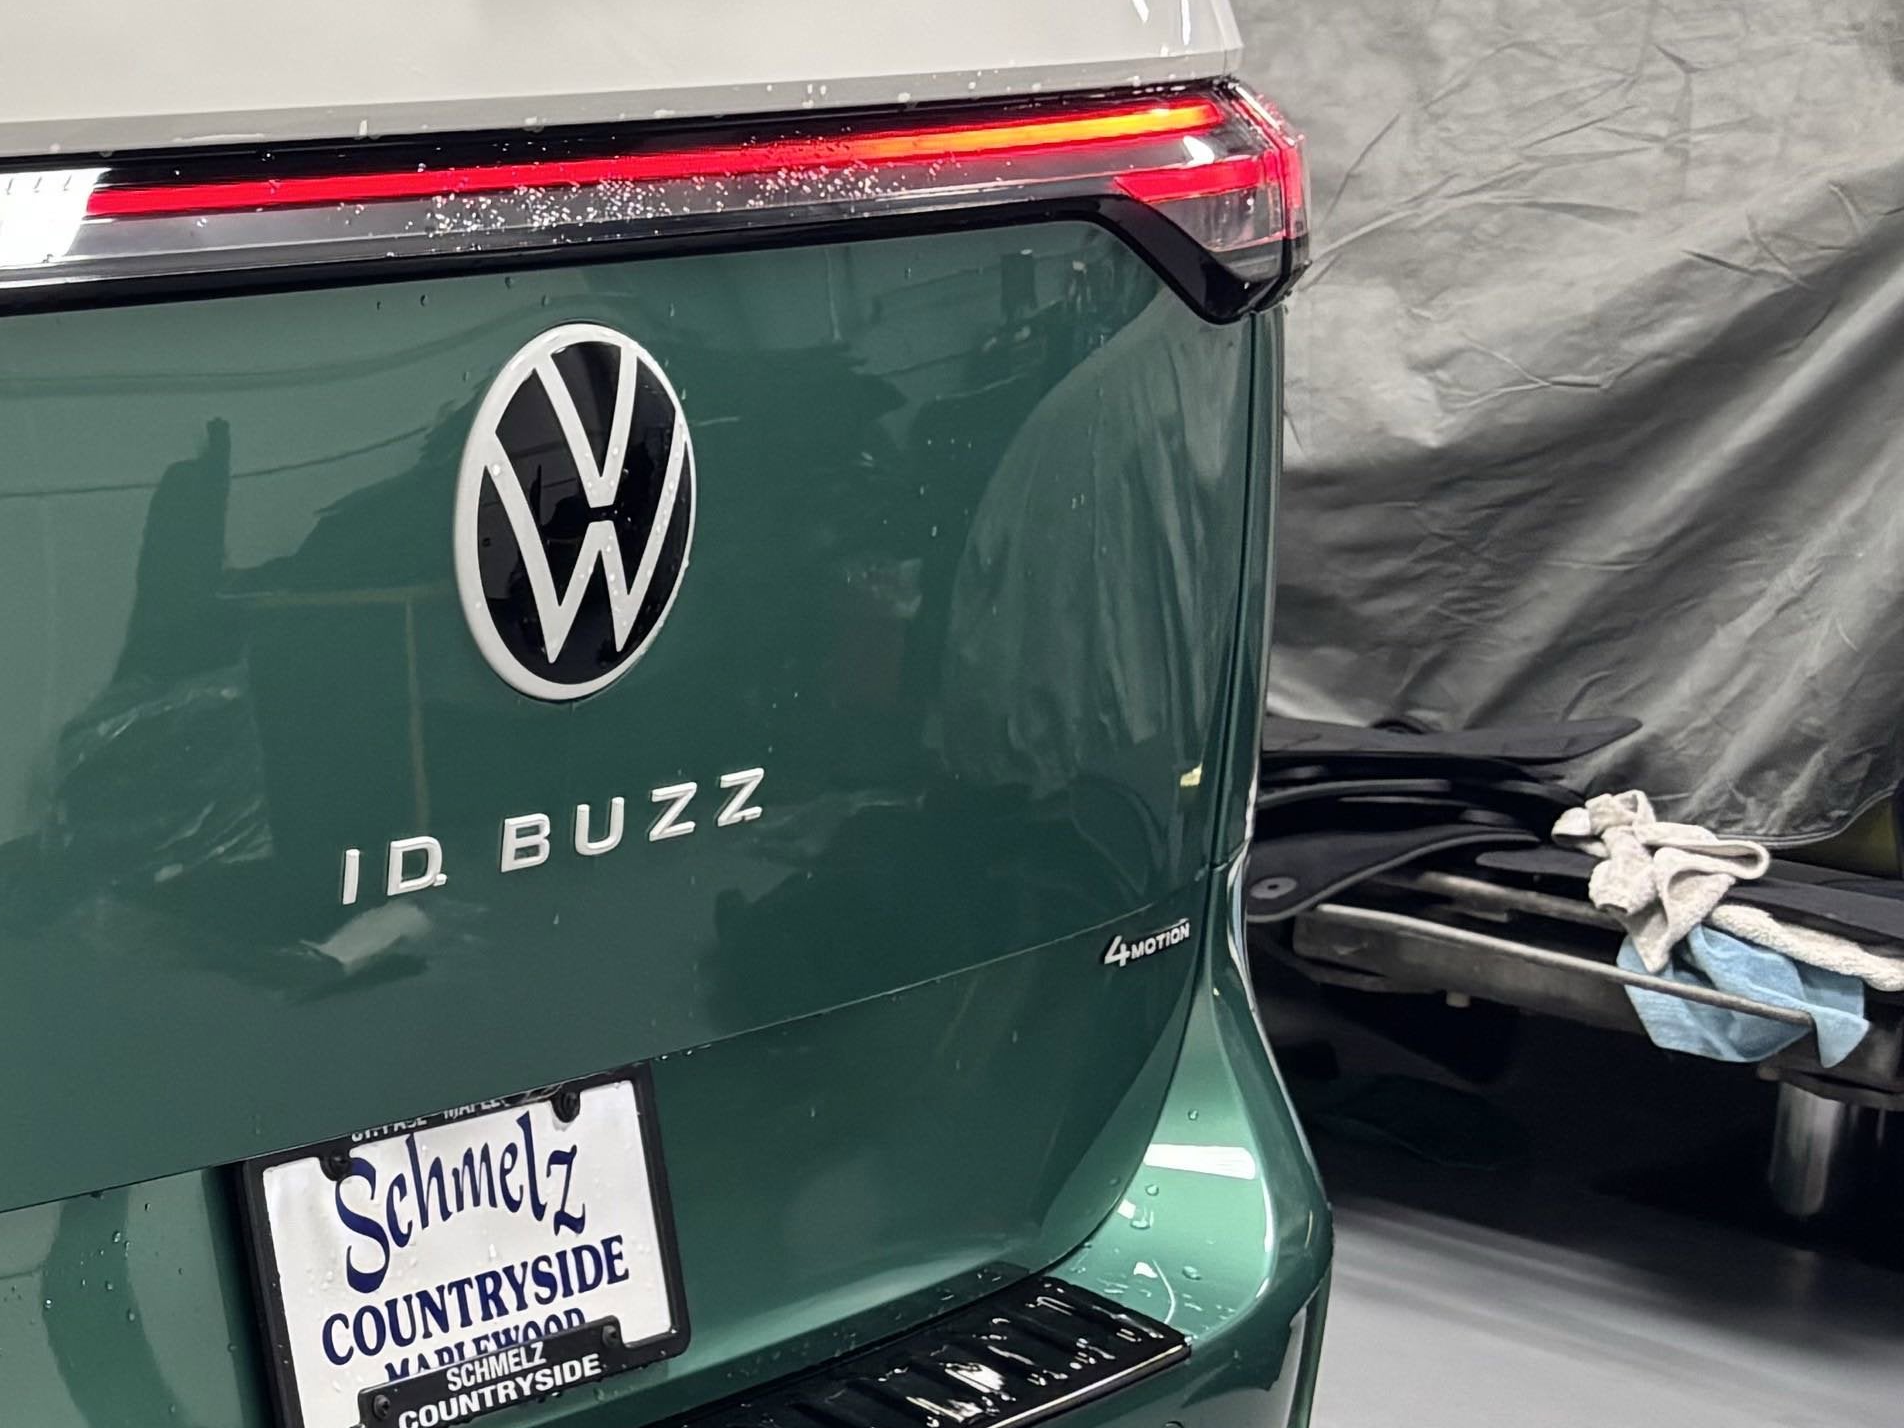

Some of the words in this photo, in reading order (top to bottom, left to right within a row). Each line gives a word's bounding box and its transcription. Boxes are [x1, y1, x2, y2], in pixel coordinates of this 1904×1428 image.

[462, 330, 695, 684] VW
[499, 766, 765, 873] BUZZ
[1103, 920, 1191, 968] 4MOTION
[335, 1111, 587, 1294] Schmelz
[321, 1233, 630, 1366] COUNTRYSIDE
[446, 1340, 547, 1392] SCHMELZ
